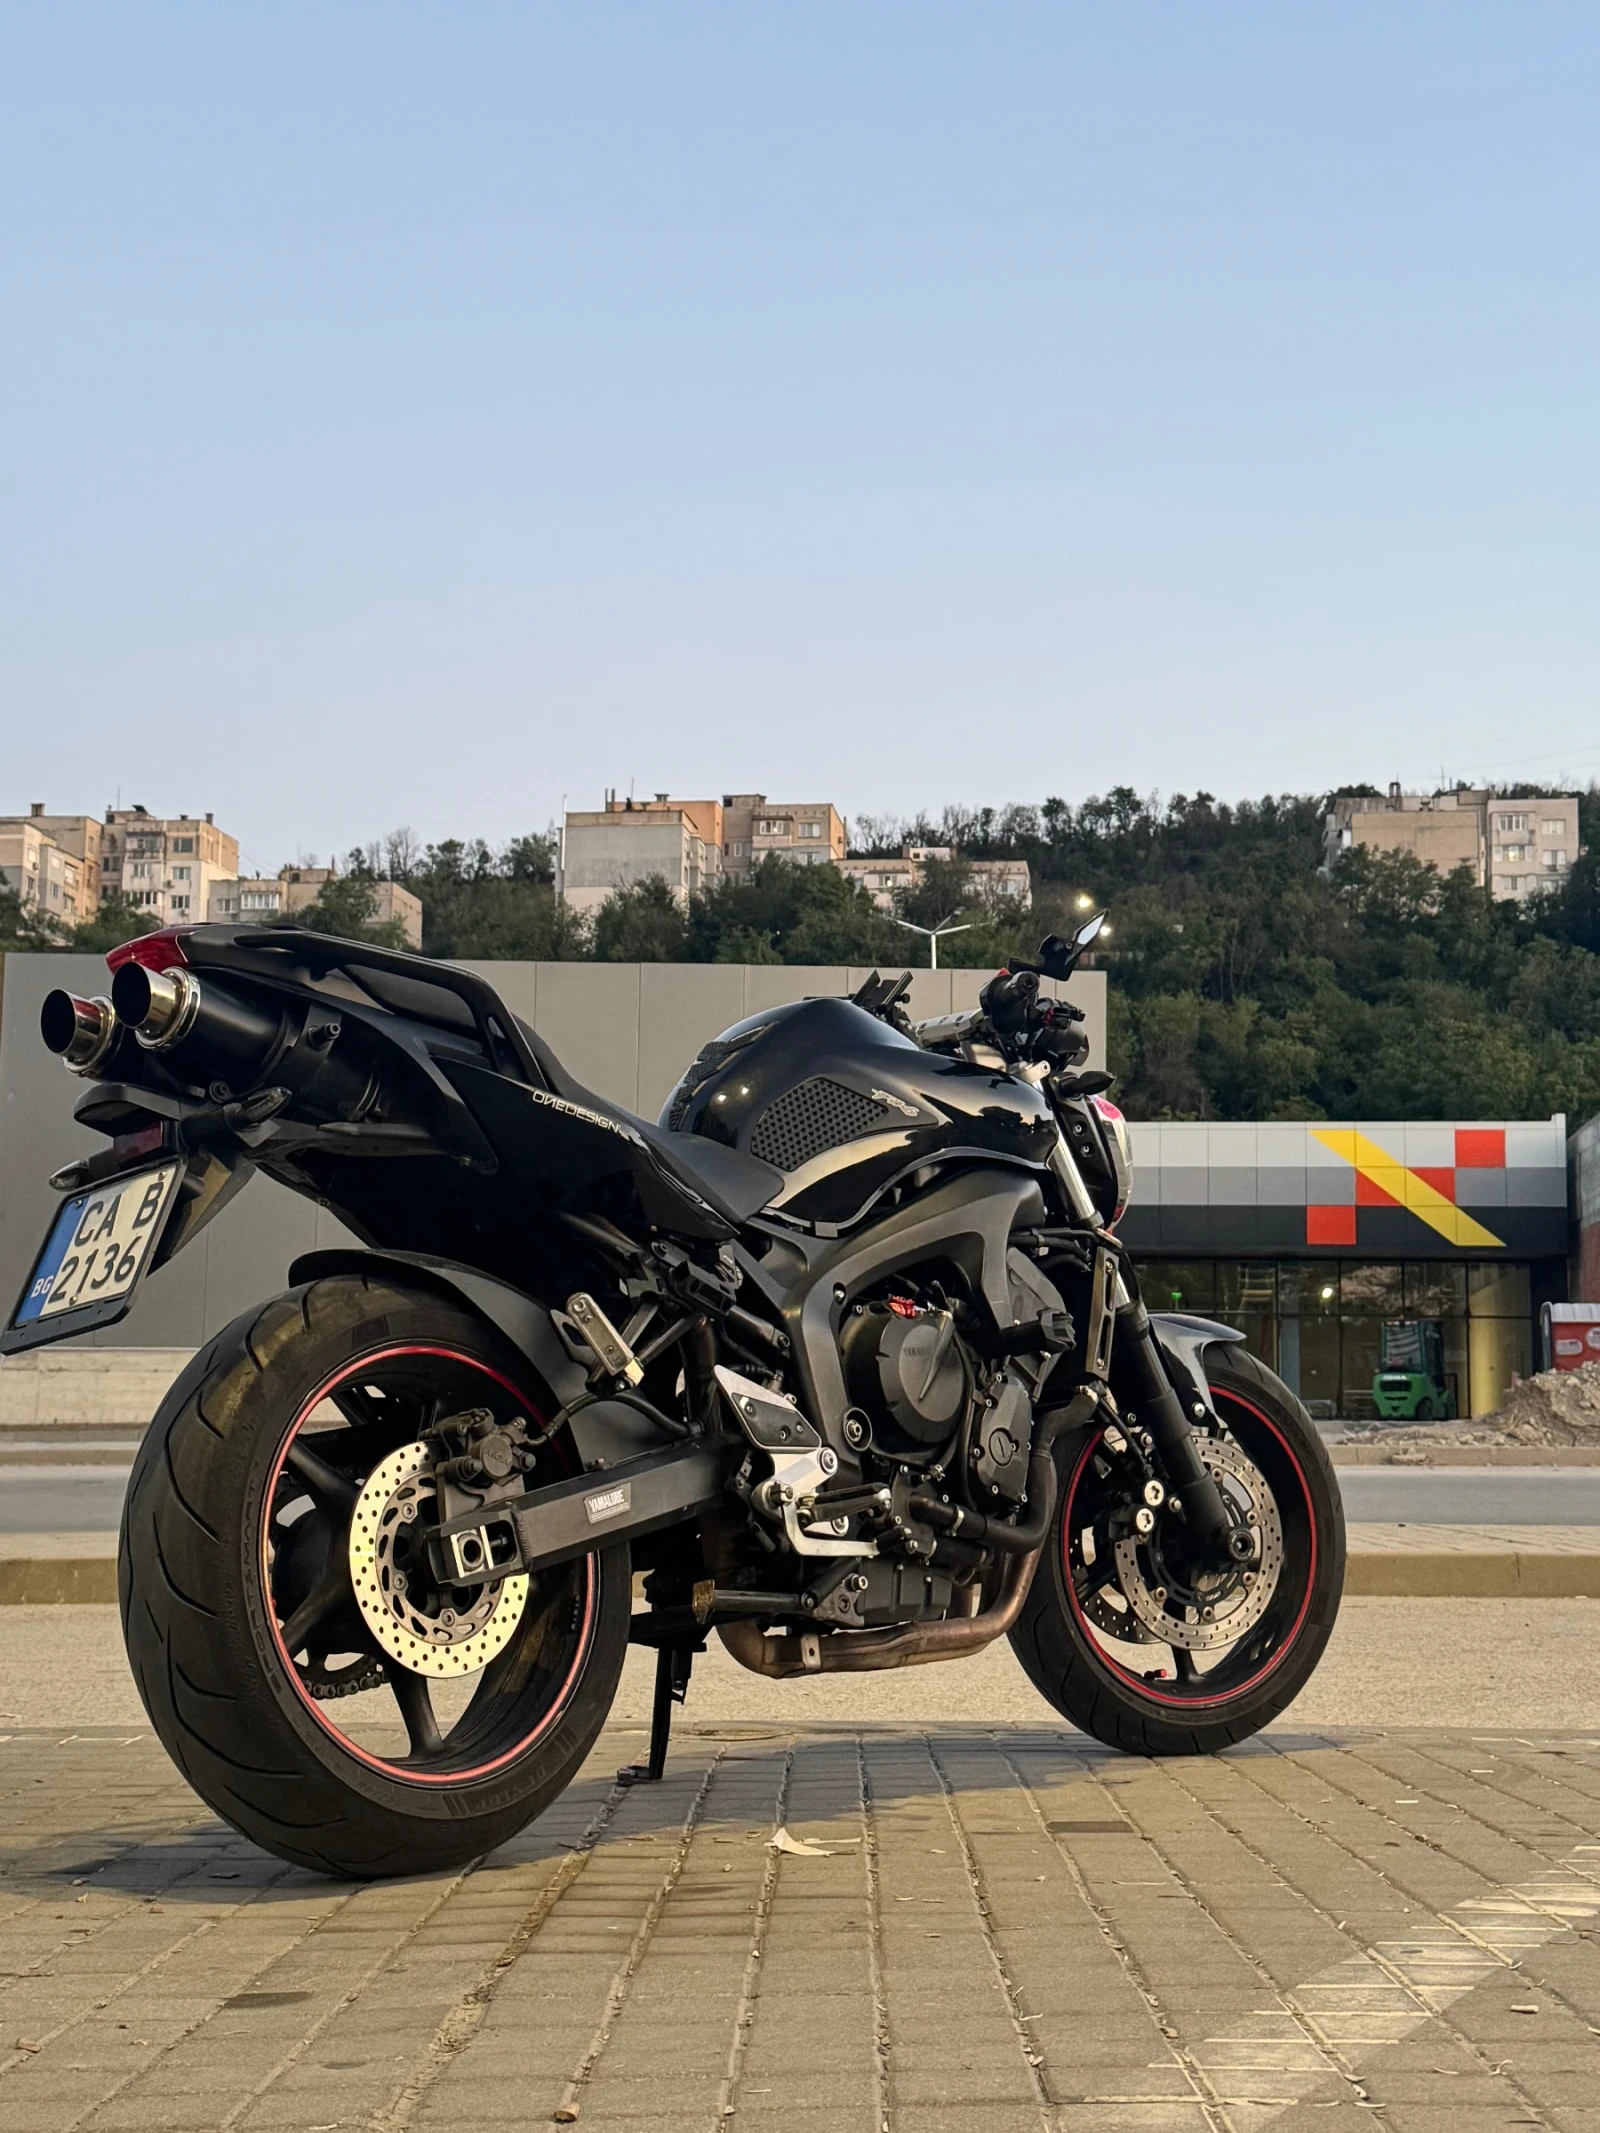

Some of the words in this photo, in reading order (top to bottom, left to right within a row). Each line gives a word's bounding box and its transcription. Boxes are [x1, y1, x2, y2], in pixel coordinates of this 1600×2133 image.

[533, 1091, 619, 1133] ONEDESIGN
[74, 1194, 122, 1247] CA
[132, 1182, 164, 1229] B
[31, 1275, 54, 1298] BG
[48, 1236, 142, 1304] 2136
